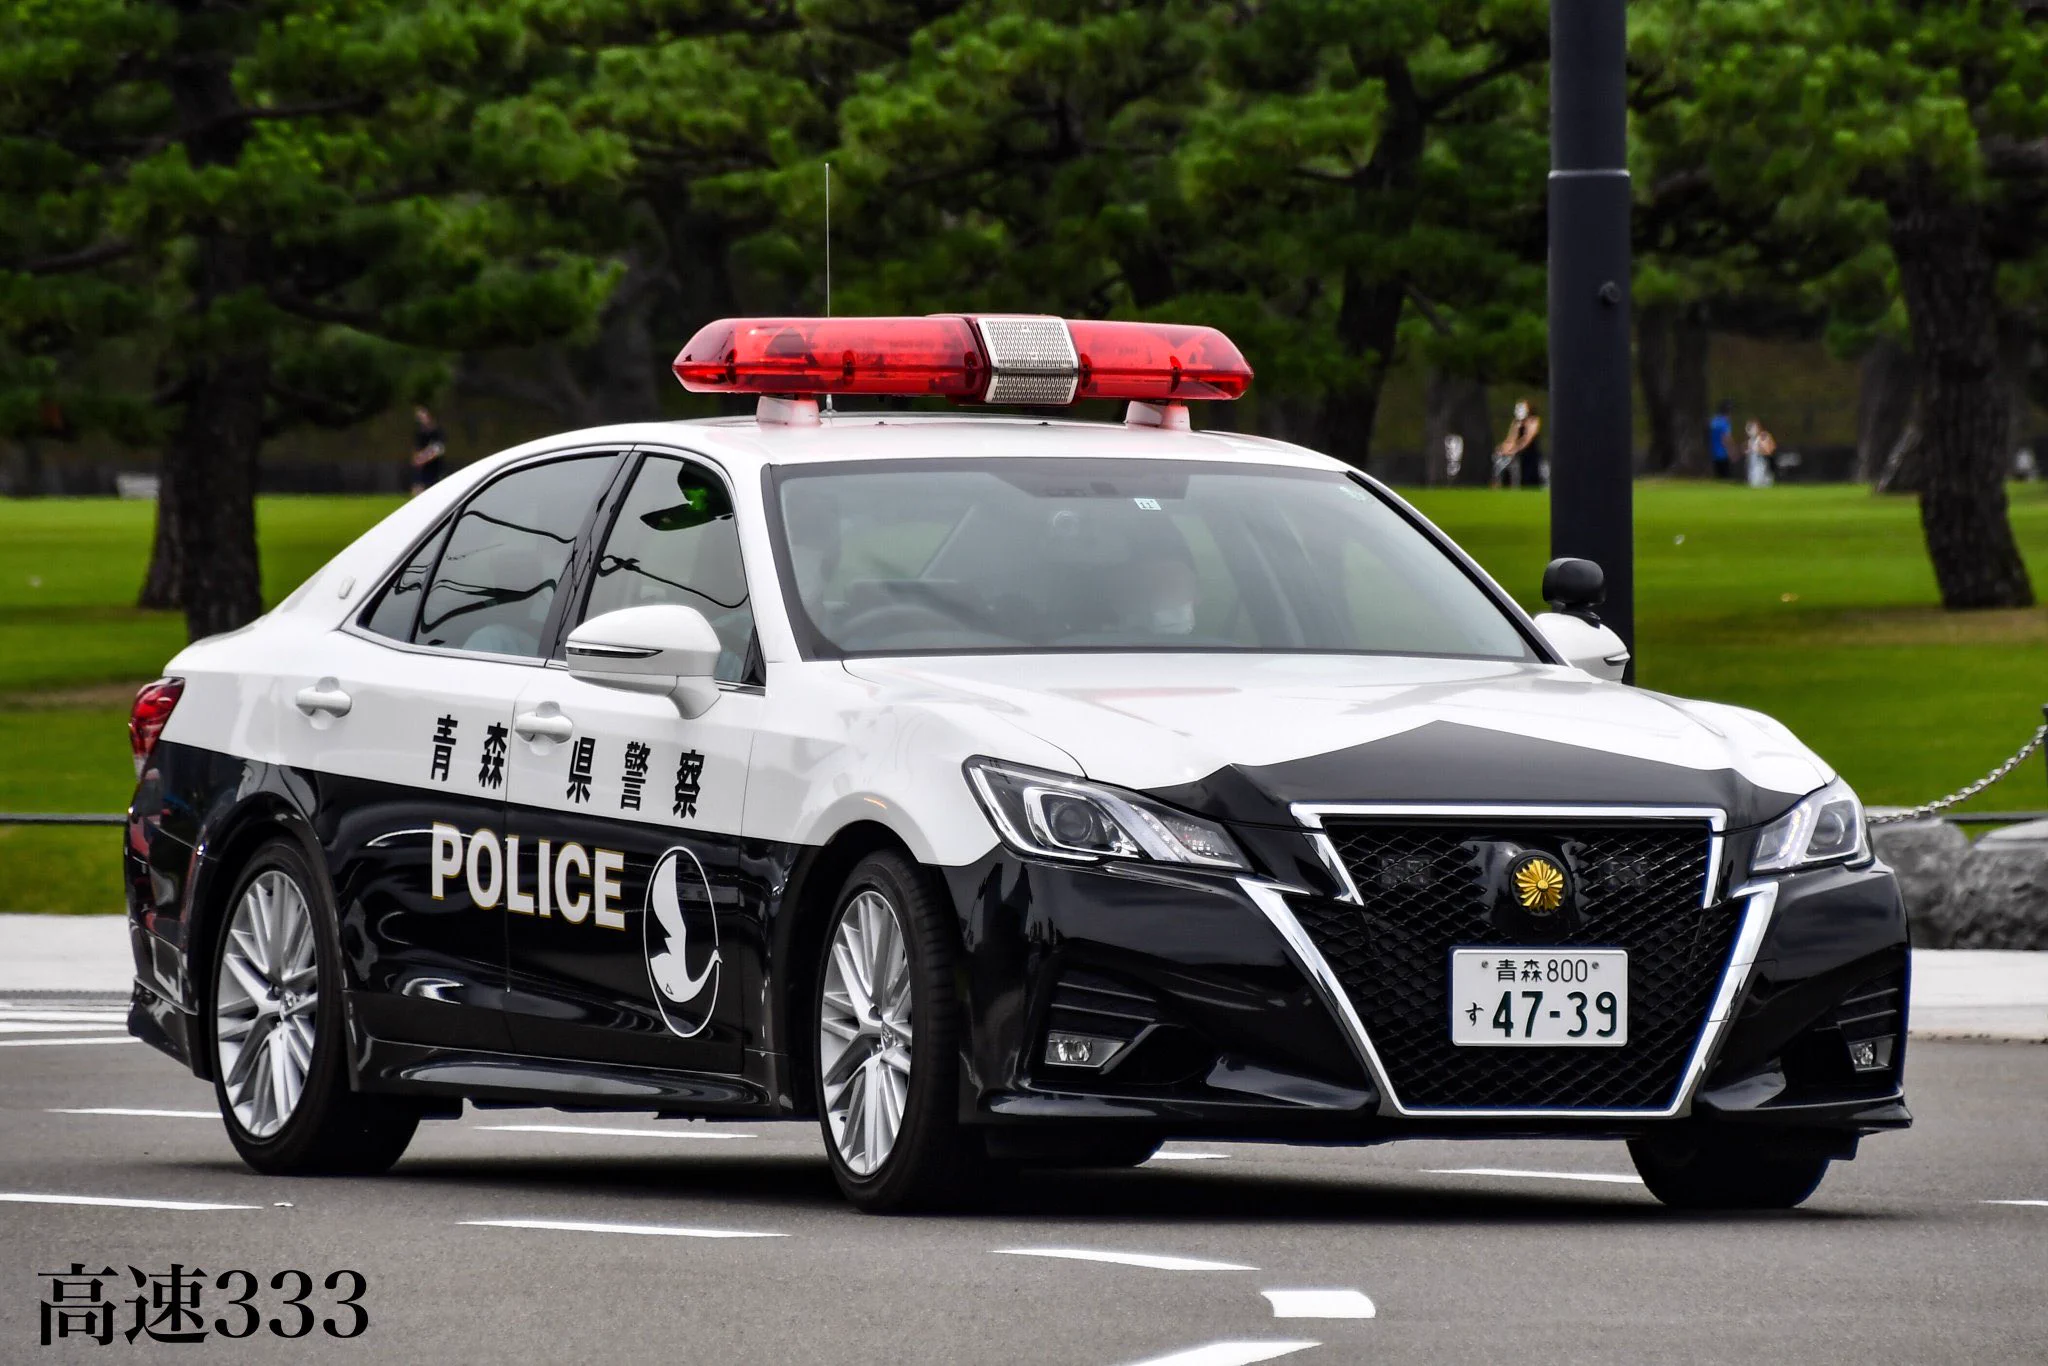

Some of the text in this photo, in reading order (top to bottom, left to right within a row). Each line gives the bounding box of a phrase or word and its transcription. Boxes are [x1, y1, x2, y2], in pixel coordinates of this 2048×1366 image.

[431, 714, 705, 819] 青森県警察
[431, 821, 626, 931] POLICE
[1496, 958, 1588, 983] 青森800
[1465, 990, 1617, 1038] す 47-39
